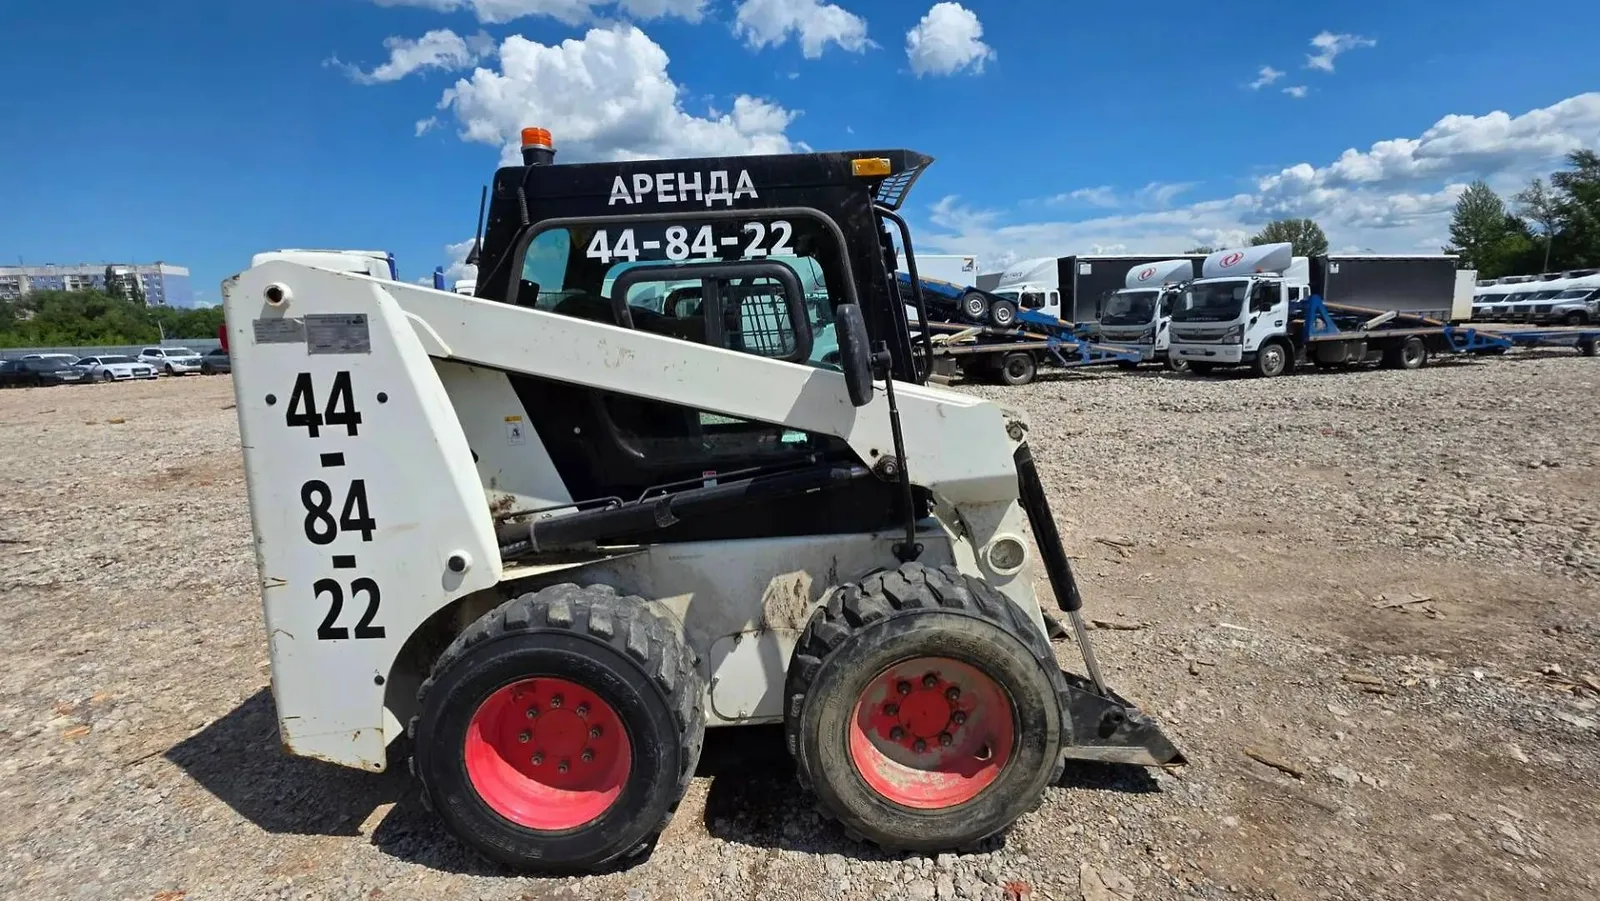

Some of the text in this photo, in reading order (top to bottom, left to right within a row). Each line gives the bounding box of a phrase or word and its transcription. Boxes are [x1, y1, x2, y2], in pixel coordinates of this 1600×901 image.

[608, 169, 759, 207] АРЕНДА
[586, 220, 794, 264] 44-84-22
[286, 370, 362, 438] 44
[300, 479, 377, 545] 84
[313, 577, 386, 640] 22
